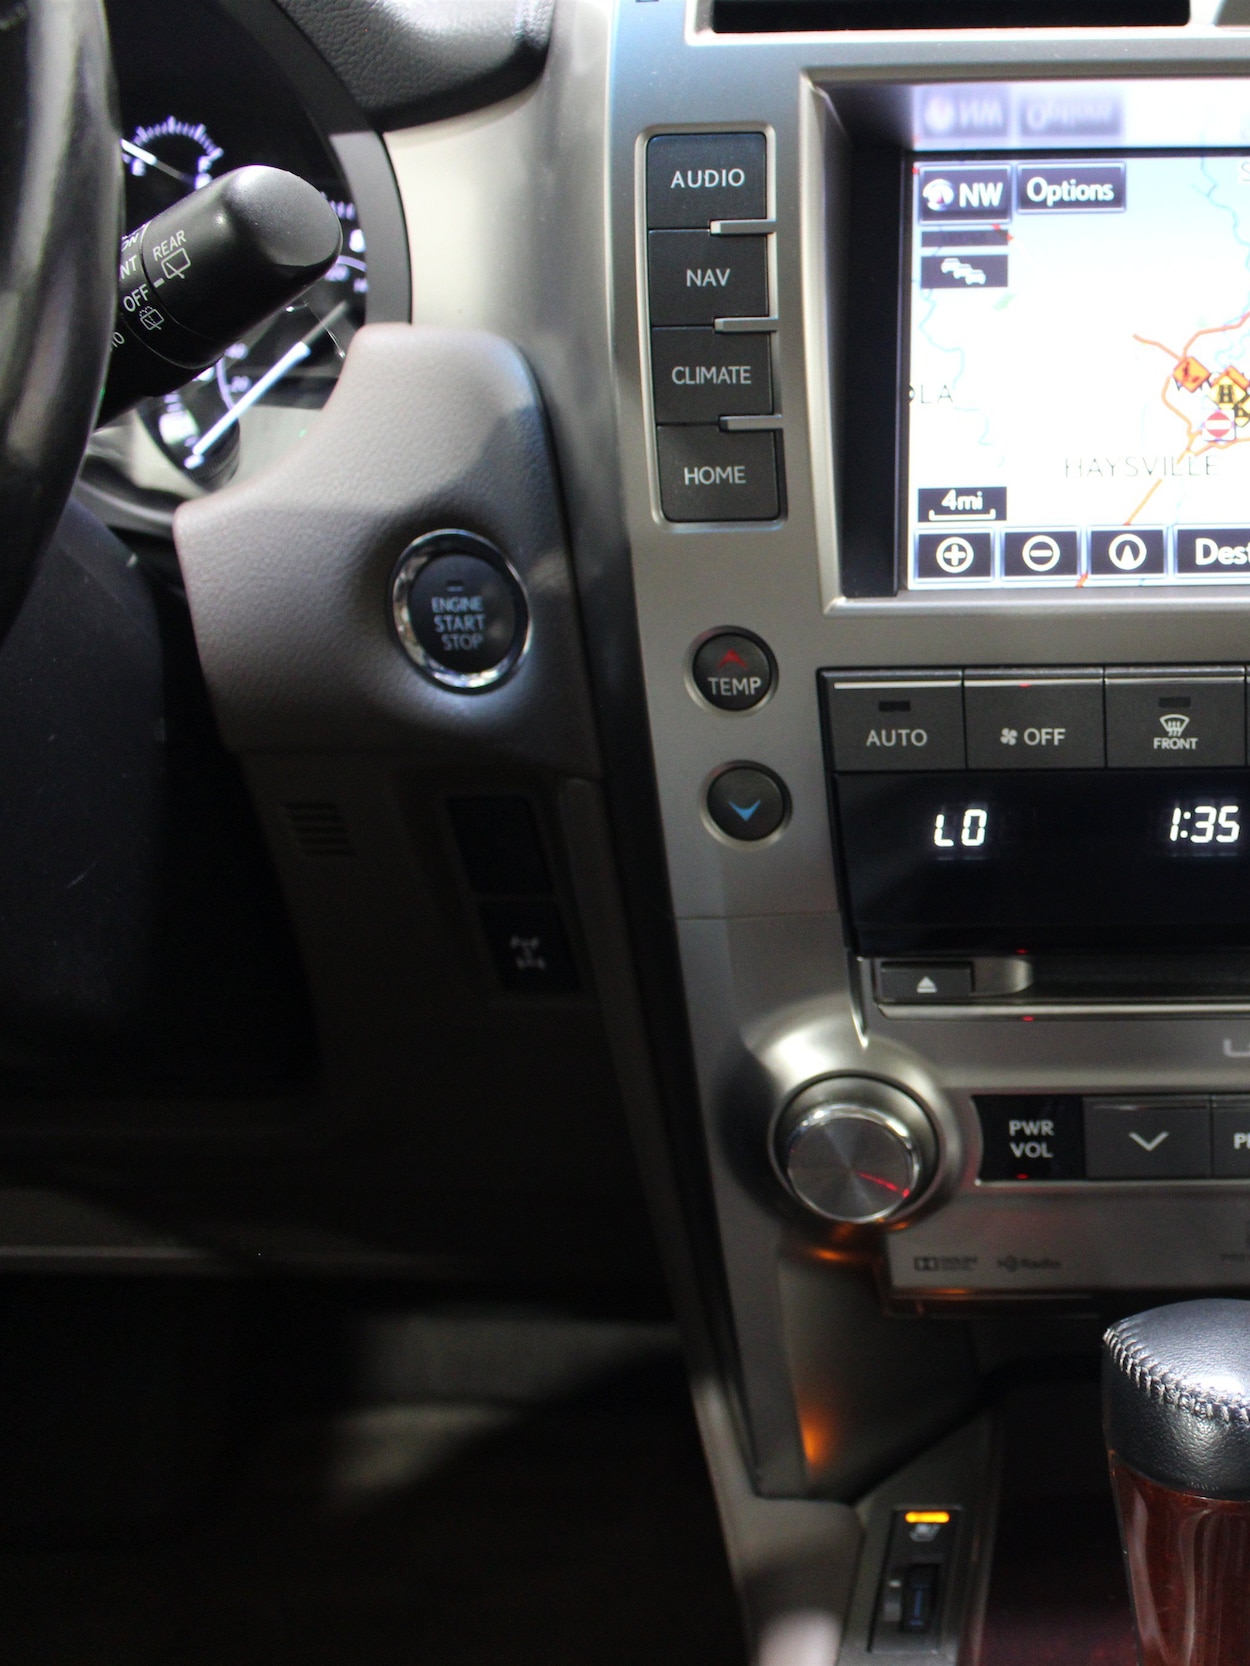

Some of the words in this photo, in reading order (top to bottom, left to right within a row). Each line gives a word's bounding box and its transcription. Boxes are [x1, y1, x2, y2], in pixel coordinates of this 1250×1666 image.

[670, 168, 745, 189] AUDIO
[958, 182, 1004, 208] NW
[1026, 176, 1115, 207] Options
[152, 229, 187, 262] REAR
[686, 268, 731, 288] NAV
[123, 283, 149, 312] OFF
[671, 365, 752, 386] CLIMATE
[684, 465, 747, 486] HOME
[1064, 455, 1219, 478] HAYSVILLE
[941, 488, 984, 511] 4mi
[430, 596, 485, 613] ENGINE
[433, 613, 486, 633] START
[441, 633, 484, 651] STOP
[708, 676, 762, 696] TEMP
[866, 728, 928, 747] AUTO
[1023, 728, 1066, 746] OFF
[1153, 737, 1199, 750] FRONT
[933, 808, 988, 848] LO
[1169, 805, 1241, 844] 1:35
[1008, 1119, 1055, 1137] PWR
[1008, 1140, 1055, 1159] VOL
